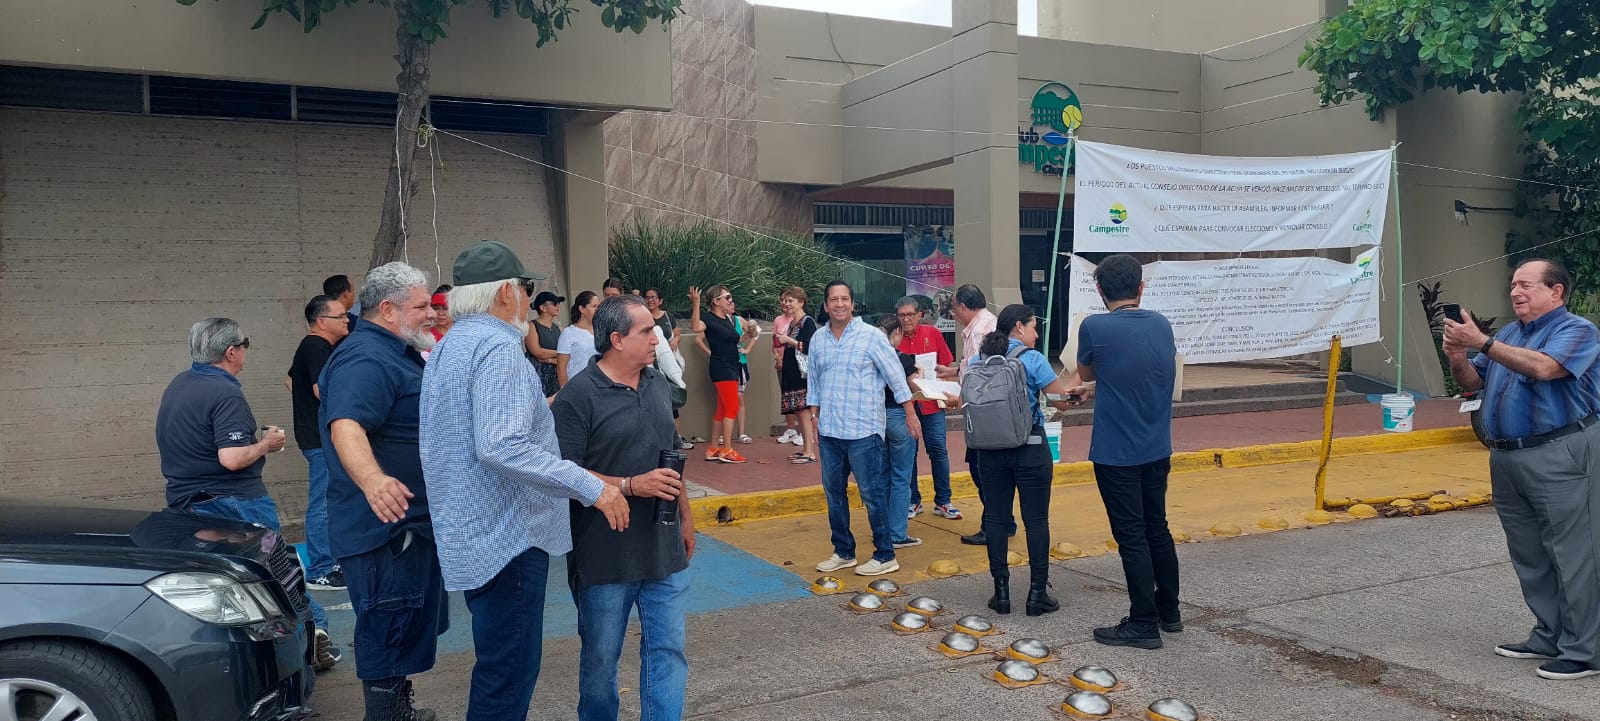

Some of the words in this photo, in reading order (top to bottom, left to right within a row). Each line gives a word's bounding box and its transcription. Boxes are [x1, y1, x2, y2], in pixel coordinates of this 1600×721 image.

[1018, 126, 1039, 143] lub
[1115, 181, 1127, 189] DEL
[1151, 182, 1177, 191] CONSEJO
[1178, 183, 1209, 191] DIRECTIVO
[1089, 224, 1130, 235] Campestre
[1171, 224, 1198, 233] ESPERAN
[1198, 224, 1213, 233] PARA
[910, 263, 937, 272] CURSO
